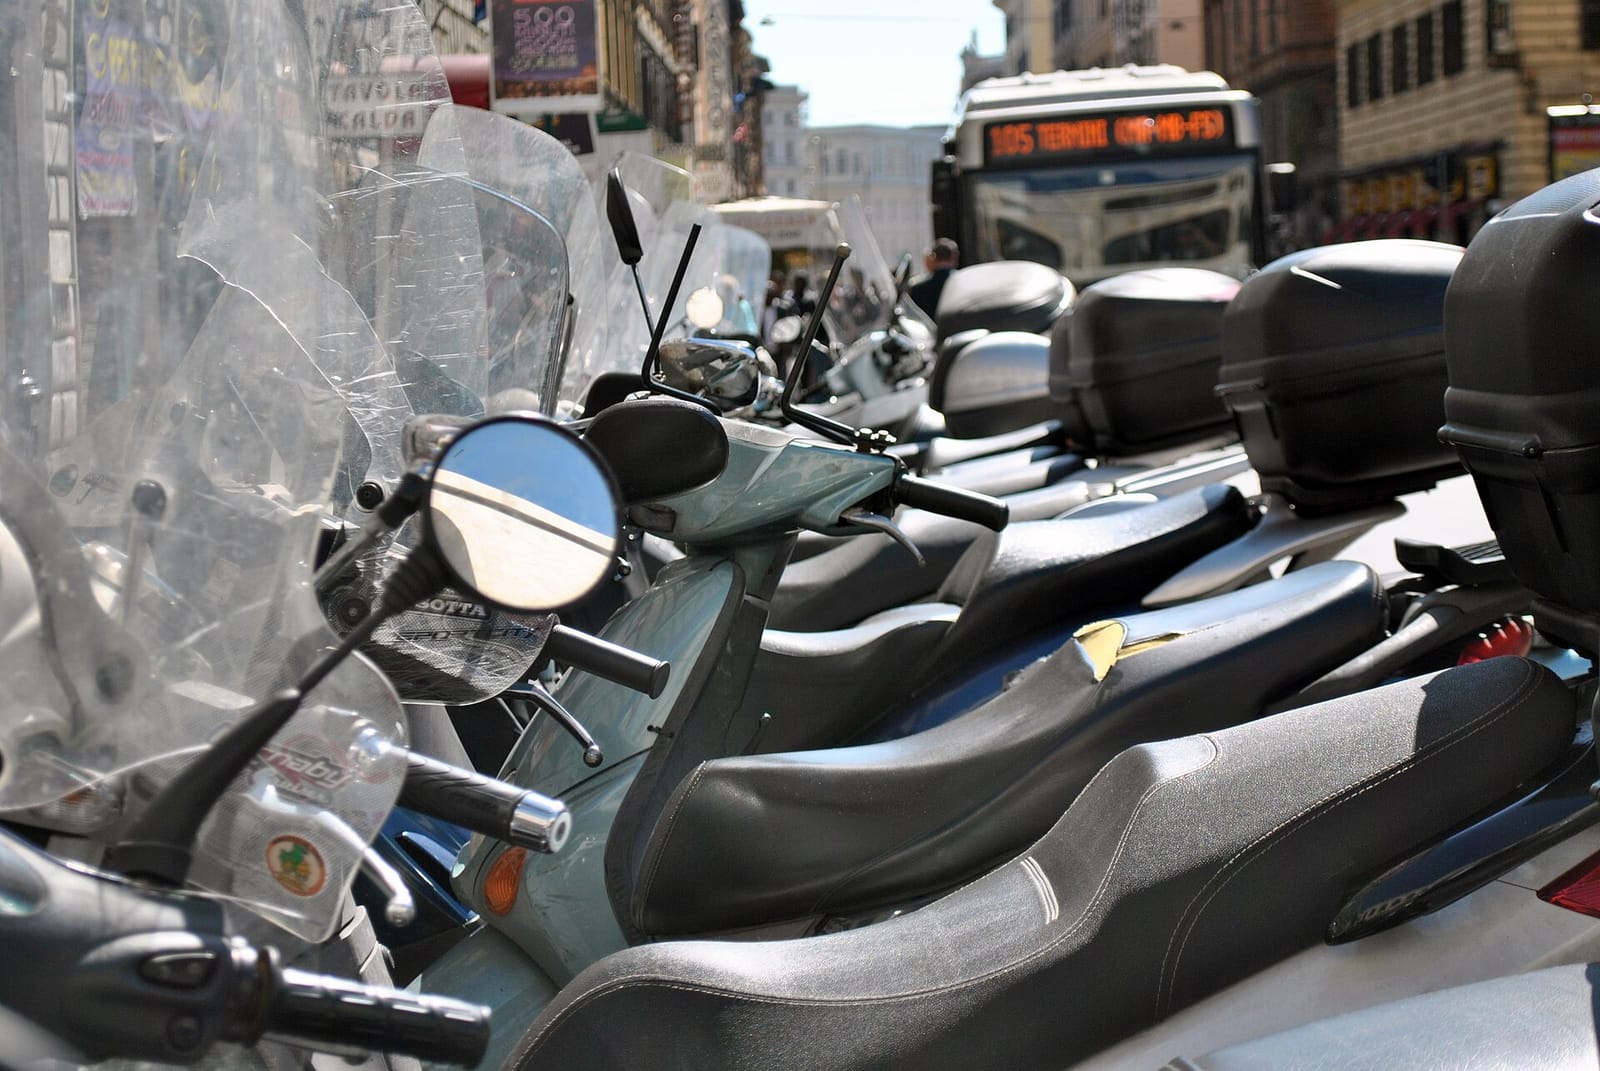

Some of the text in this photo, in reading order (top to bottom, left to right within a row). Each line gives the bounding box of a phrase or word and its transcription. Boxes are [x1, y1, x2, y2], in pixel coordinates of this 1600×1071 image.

[513, 5, 575, 27] 500
[990, 123, 1034, 157] 105
[1035, 118, 1109, 151] TERMINI
[415, 598, 487, 617] SOTTA
